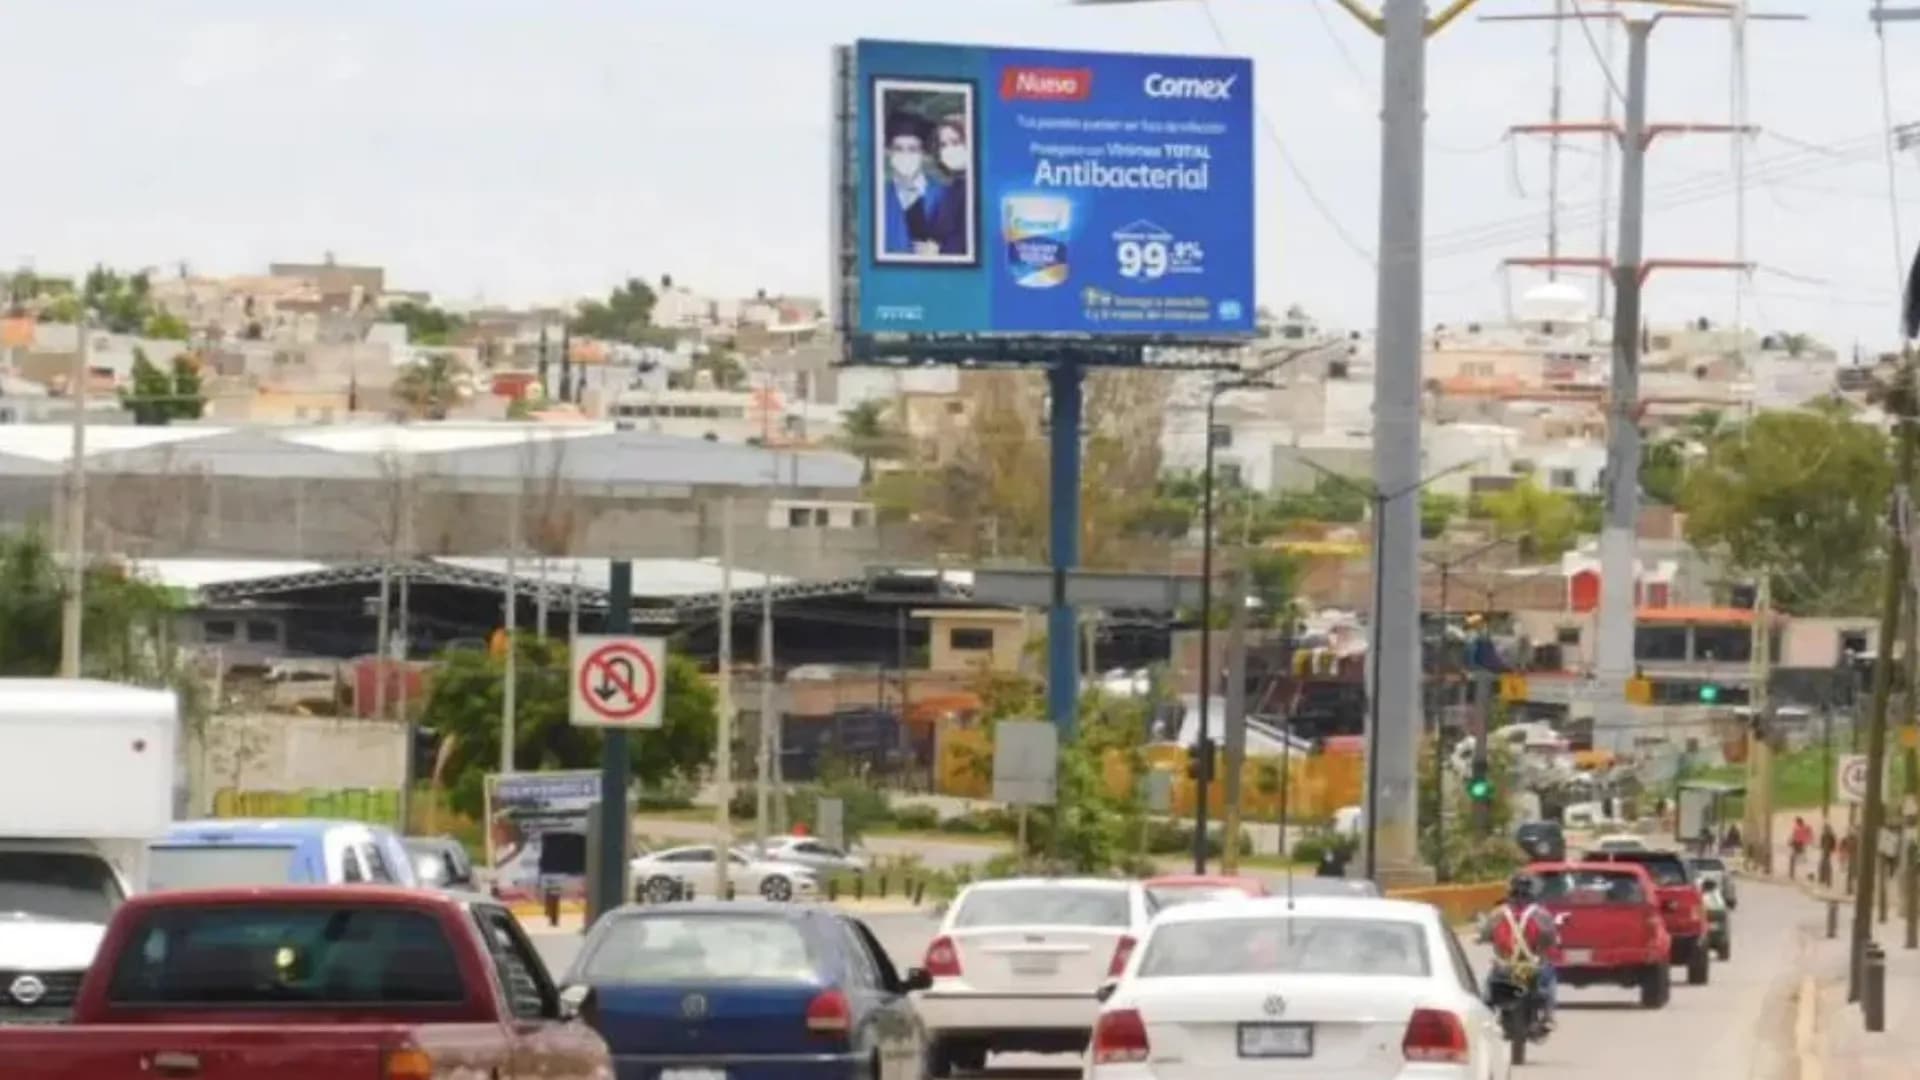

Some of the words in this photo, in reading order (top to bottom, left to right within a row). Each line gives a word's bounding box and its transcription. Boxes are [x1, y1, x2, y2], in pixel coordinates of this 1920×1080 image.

[1015, 71, 1078, 95] Nuevo
[1143, 72, 1237, 99] Comex
[1163, 143, 1212, 159] TOTAL
[1033, 159, 1209, 191] Antibacterial
